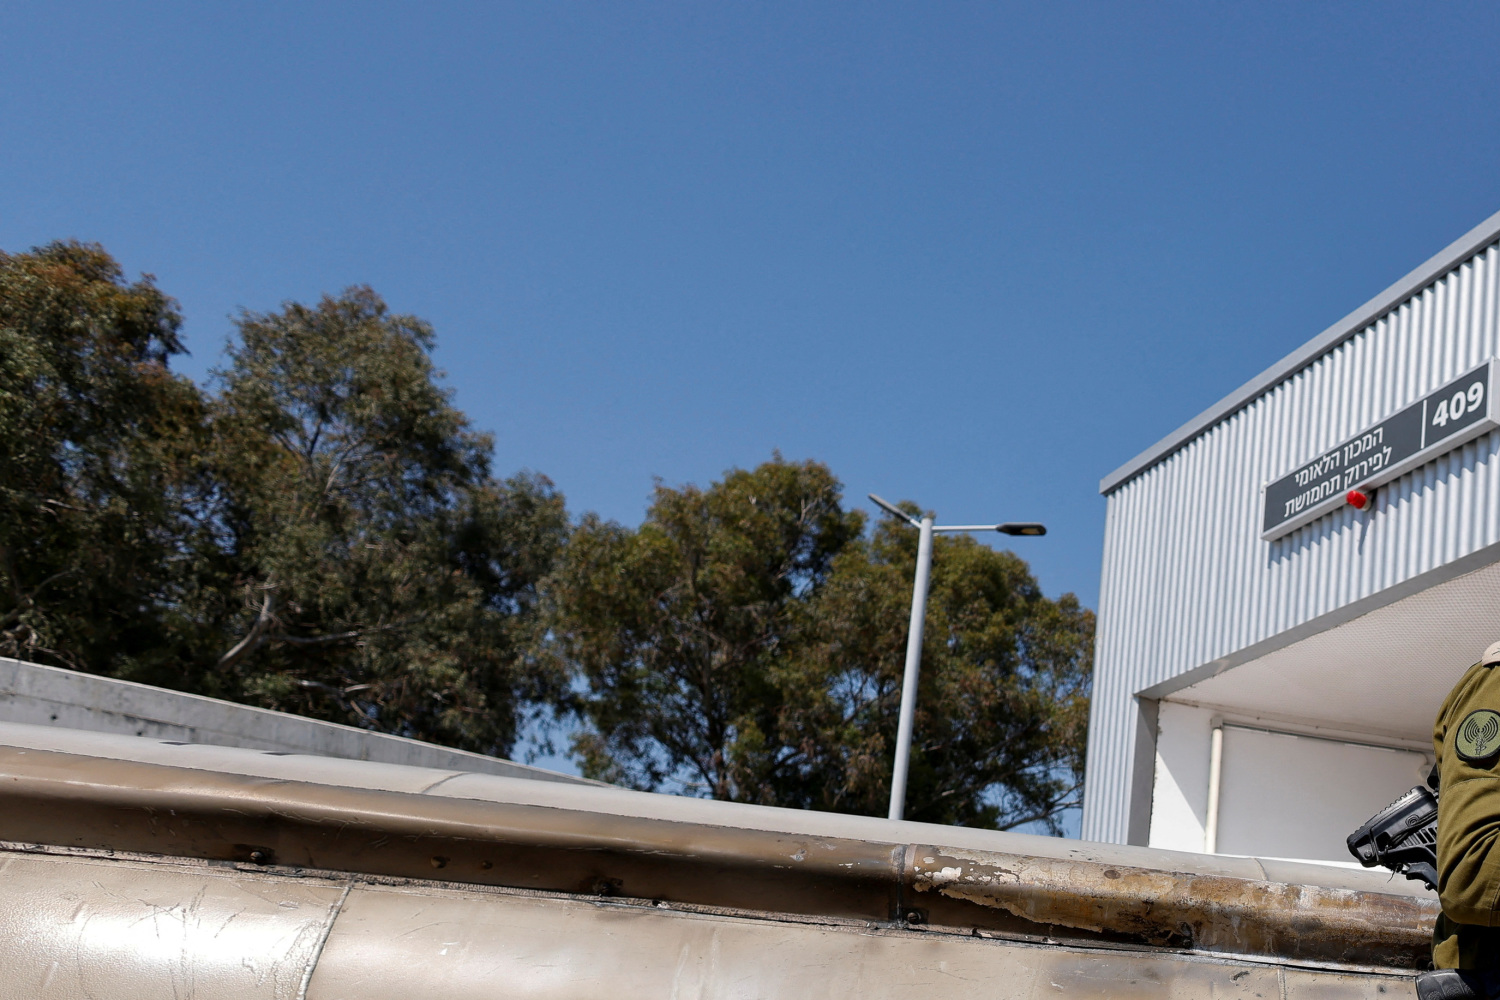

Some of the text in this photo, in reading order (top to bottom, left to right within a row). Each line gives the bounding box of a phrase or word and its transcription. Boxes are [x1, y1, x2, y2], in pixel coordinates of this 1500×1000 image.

[1432, 381, 1484, 428] 409
[1283, 446, 1392, 518] לפירוק תחמושת
[1295, 427, 1384, 487] המכון הלאומי
